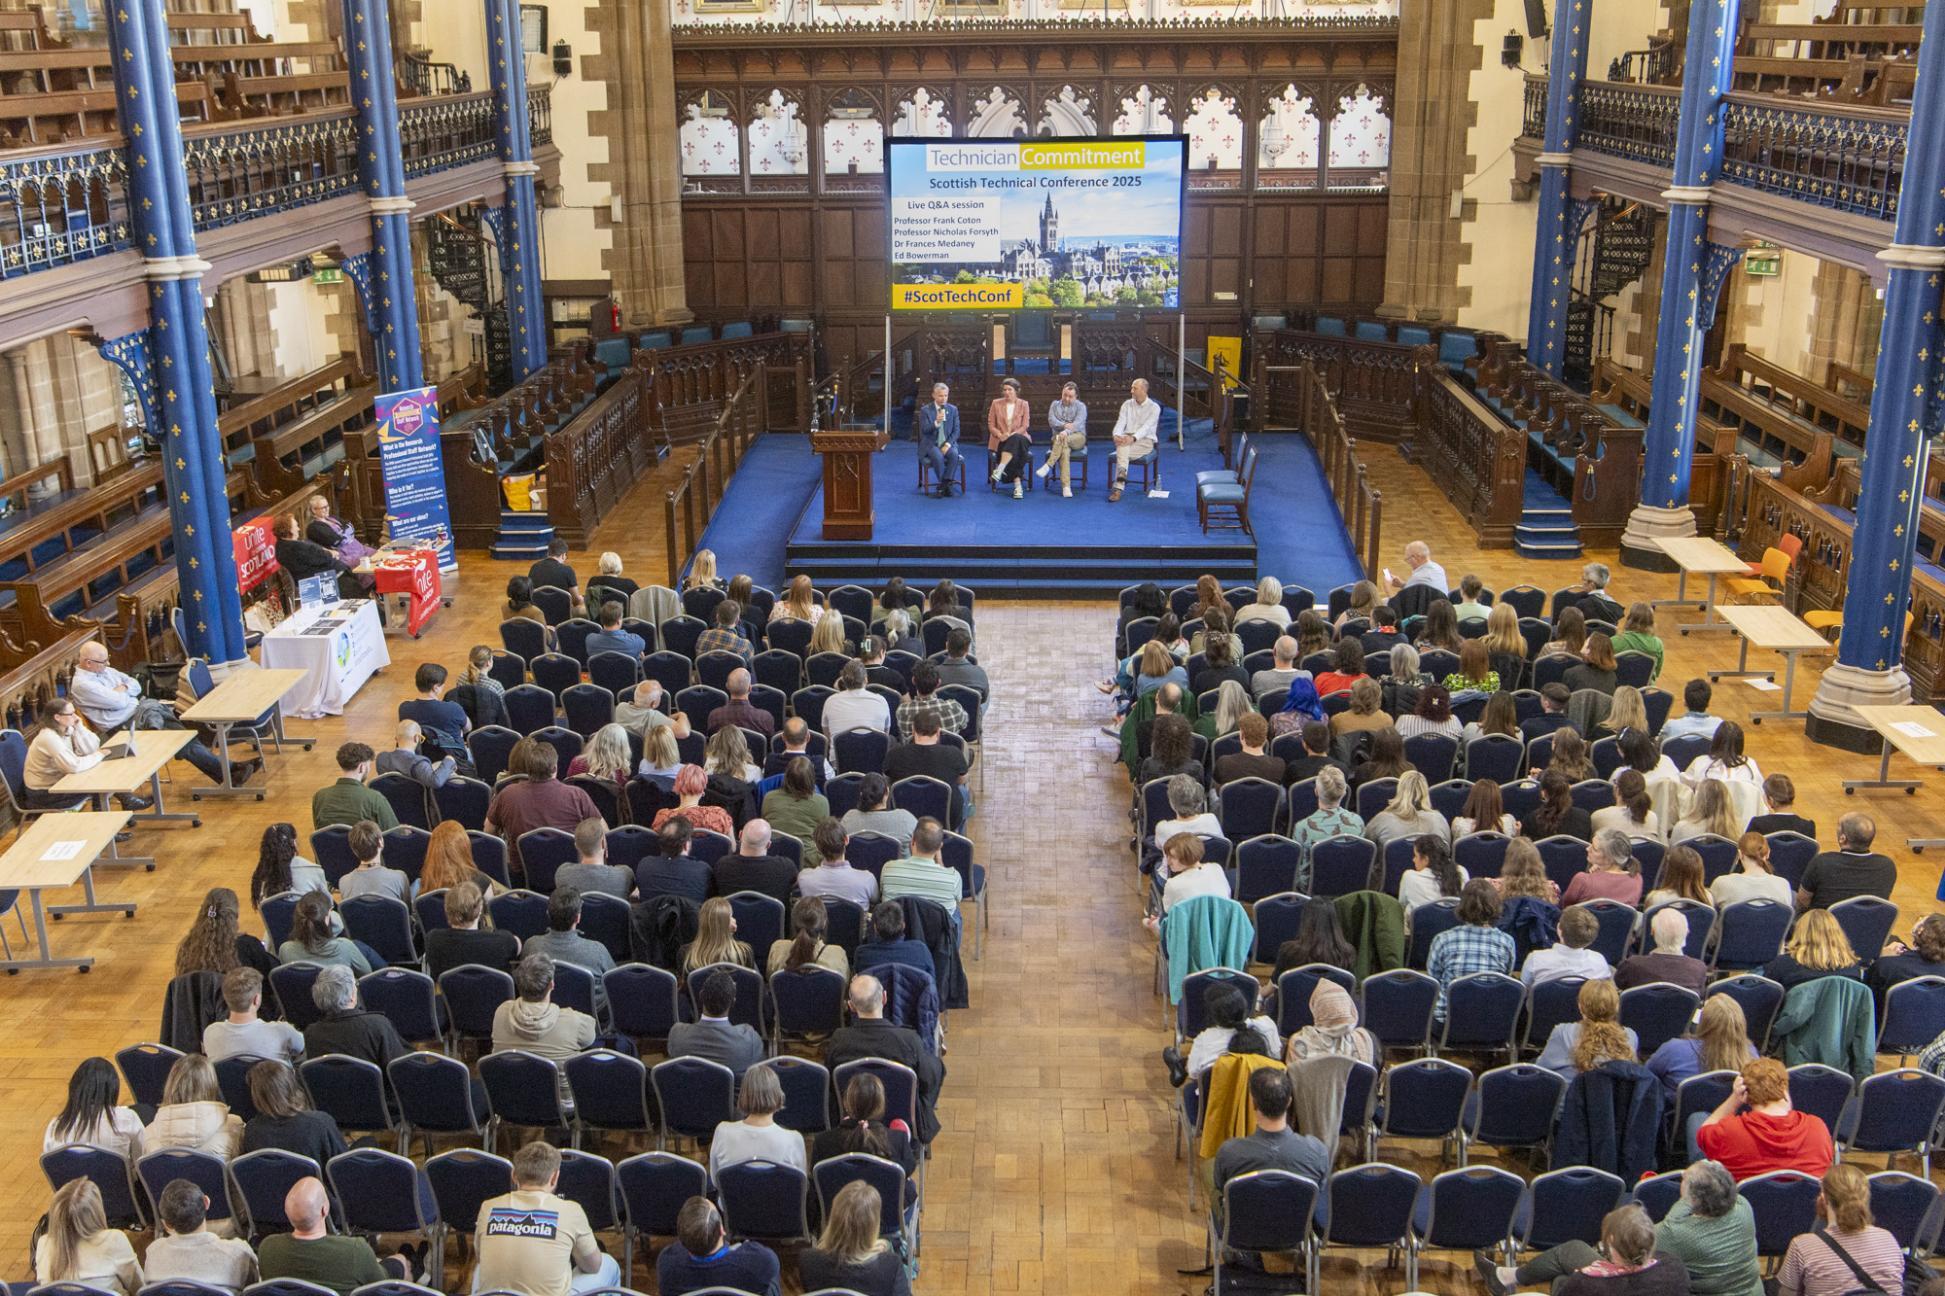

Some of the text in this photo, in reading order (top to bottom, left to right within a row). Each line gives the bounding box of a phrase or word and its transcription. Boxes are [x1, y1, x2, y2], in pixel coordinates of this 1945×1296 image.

[931, 147, 1141, 166] Technician Commitment
[930, 175, 1142, 189] Scottish Technical Conference 2025
[907, 200, 984, 210] Live Q&A session
[894, 216, 982, 225] Professor Frank Coton
[894, 227, 999, 237] Professor Nicholas Forsyth
[894, 239, 976, 249] Dr Frances Medaney
[894, 251, 949, 260] Ed Bowerman
[904, 289, 1012, 303] #ScotTechConf
[241, 544, 276, 578] SCOTLAND
[489, 1222, 552, 1236] patagonia
